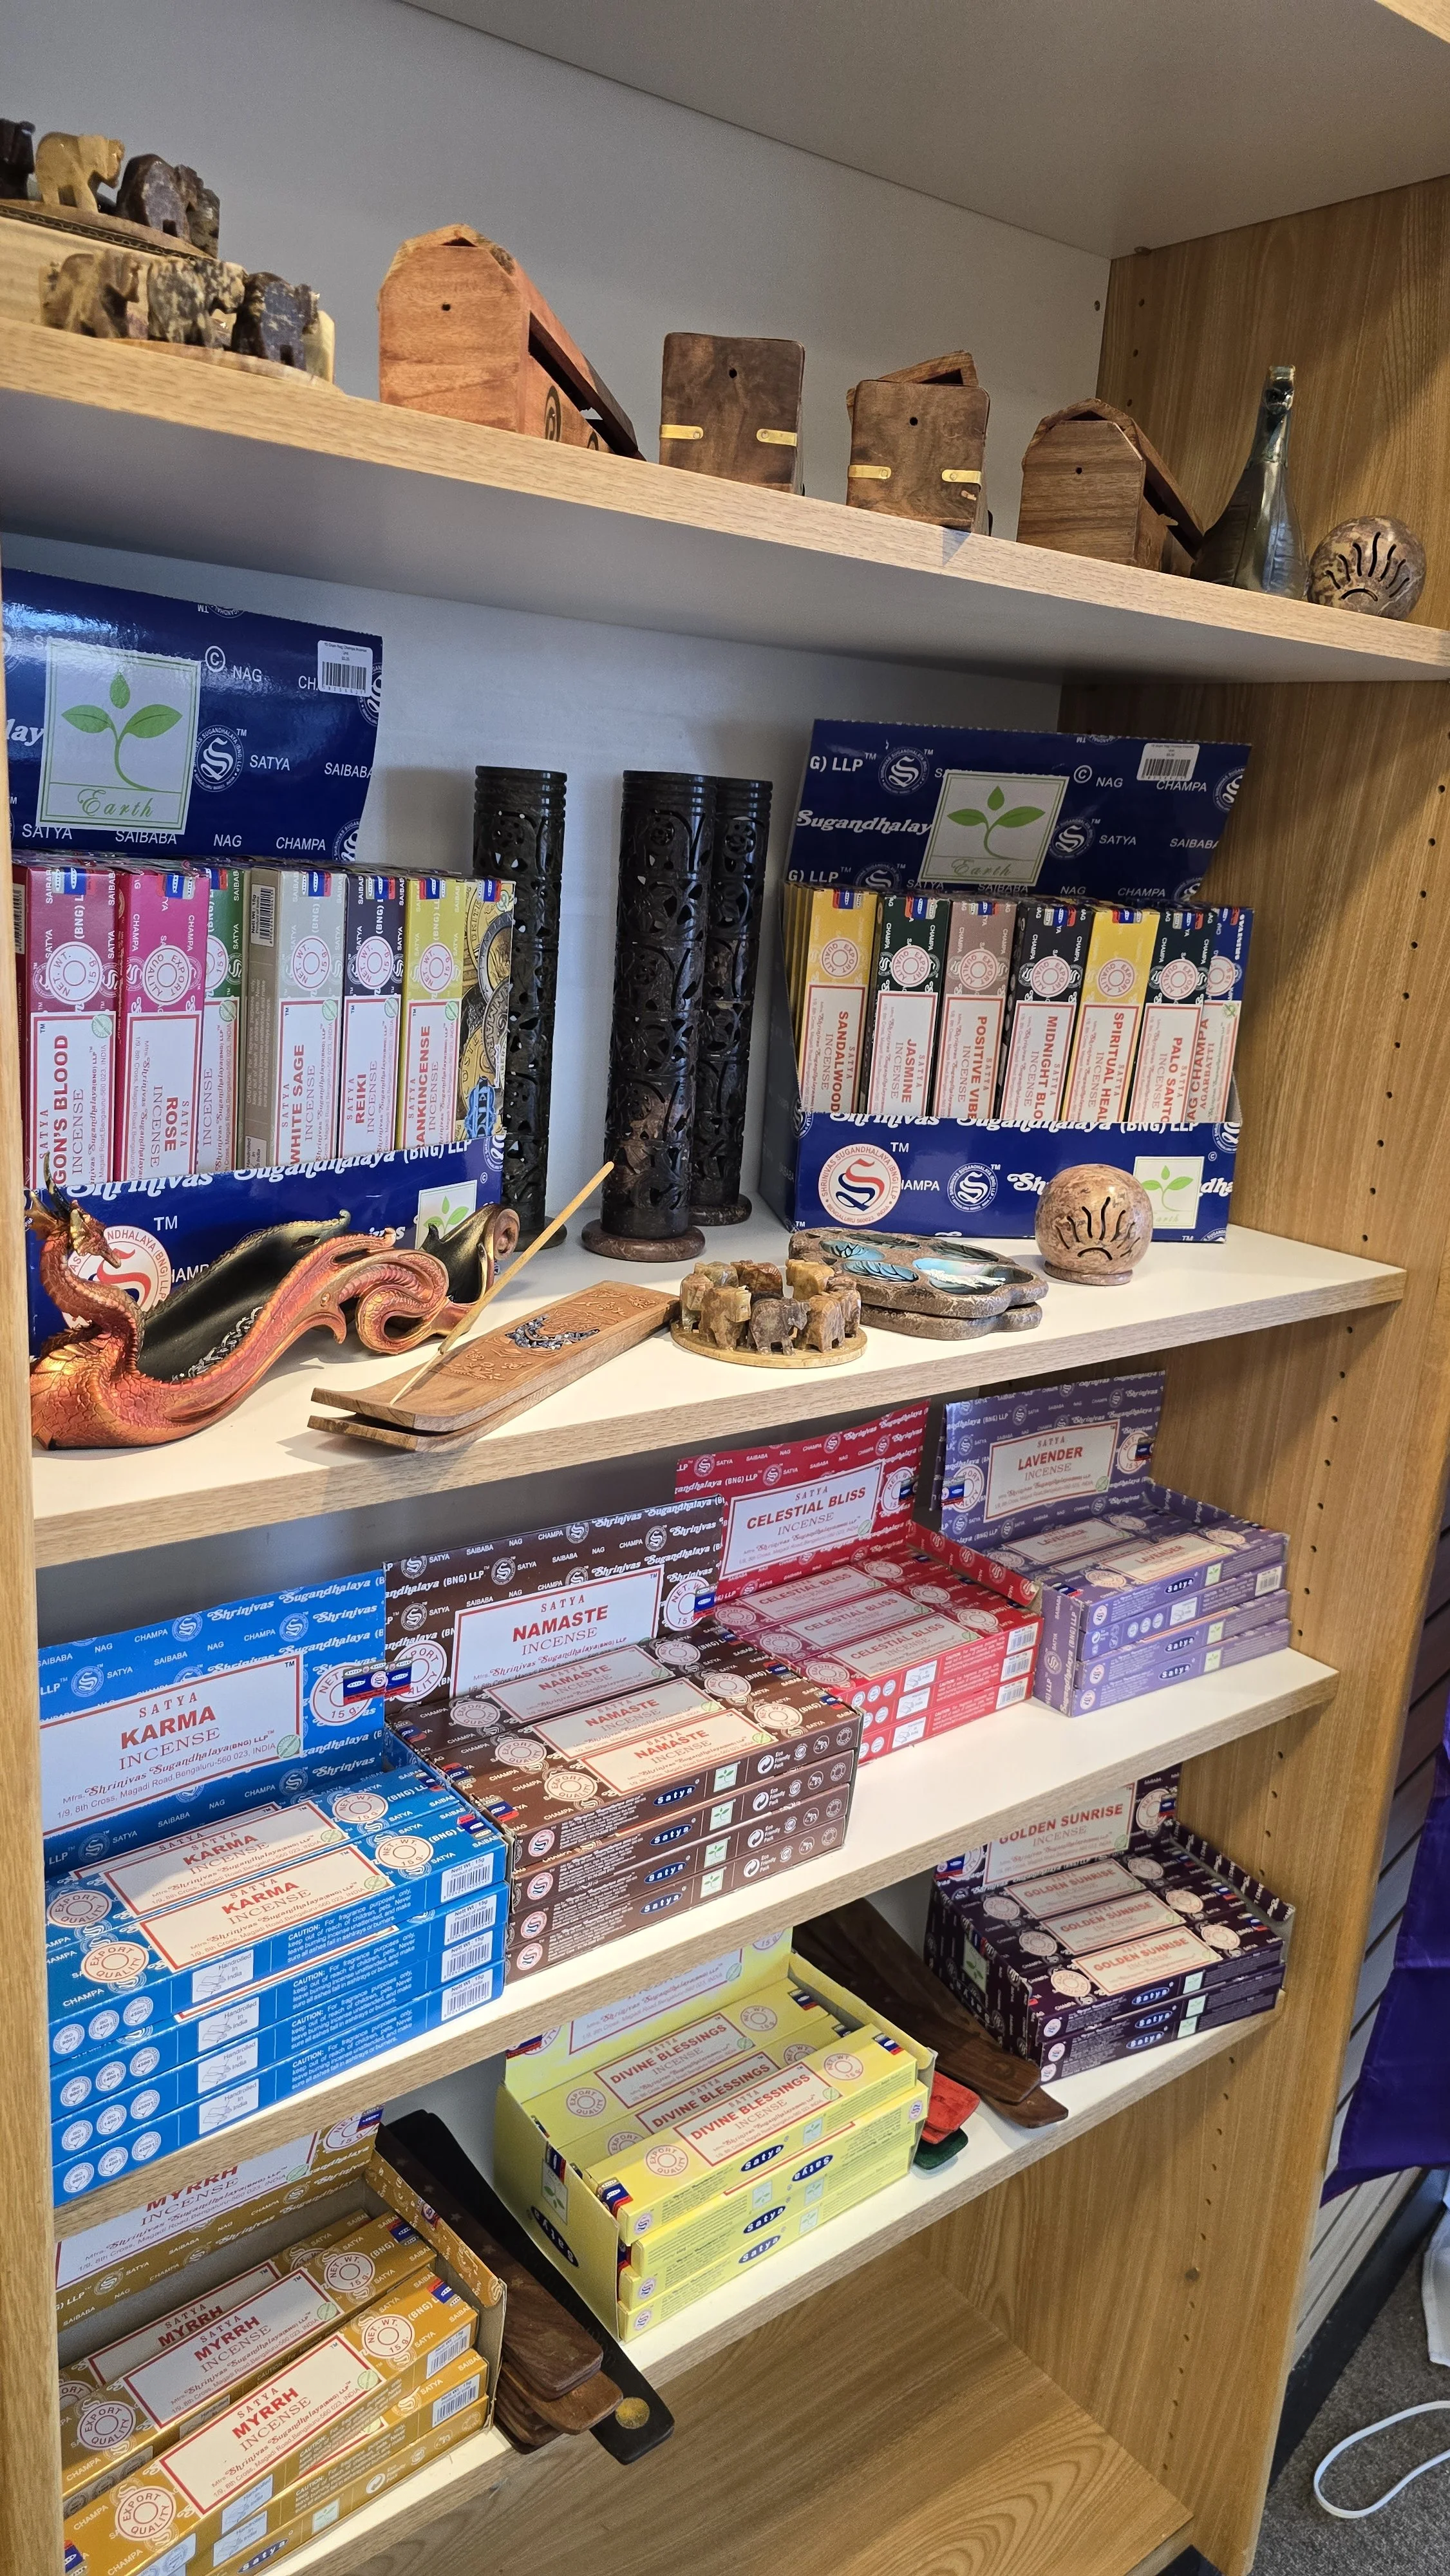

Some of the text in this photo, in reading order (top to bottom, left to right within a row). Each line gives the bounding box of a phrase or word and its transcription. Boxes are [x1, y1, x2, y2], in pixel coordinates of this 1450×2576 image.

[233, 666, 263, 683] NAG
[250, 755, 290, 771] SATYA
[832, 757, 863, 772] LLP
[1096, 777, 1124, 788] NAG
[77, 788, 153, 818] Earth
[22, 824, 326, 851] SATYA NAG CHAMPA
[1099, 835, 1136, 846] SATYA
[808, 870, 839, 884] LLP
[951, 858, 1012, 878] Earth
[1060, 885, 1166, 898] NAG CHAMPA
[311, 902, 319, 934] (BNG)
[821, 1033, 833, 1091] INCENSE
[830, 1010, 849, 1112] SANDALWOOD
[890, 1042, 904, 1099] INCENSE
[901, 1038, 917, 1104] JASMINE
[968, 1016, 987, 1119] POSITIVE VIBE
[1033, 1016, 1058, 1119] MIDNIGHT BLO
[1097, 1012, 1124, 1122] SPIRITUAL HEAL
[1191, 1019, 1209, 1092] CHAMPA
[53, 1035, 69, 1111] BLOOD
[957, 1046, 971, 1103] INCENSE
[1024, 1051, 1039, 1106] INCENSE
[1088, 1052, 1104, 1108] INCENSE
[1152, 1054, 1167, 1109] INCENSE
[1161, 1037, 1183, 1122] PALO SANTO
[1200, 1043, 1214, 1109] AGARBATTI
[203, 1068, 212, 1146] INCENSE
[290, 1044, 306, 1164] WHITE SAGE
[305, 1065, 315, 1141] INCENSE
[355, 1073, 367, 1124] REIKI
[366, 1060, 378, 1133] INCENSE
[429, 1061, 438, 1131] INCENSE
[71, 1088, 84, 1175] INCENSE
[151, 1085, 164, 1168] INCENSE
[164, 1097, 179, 1151] ROSE
[180, 1100, 190, 1148] SATYA
[835, 1146, 890, 1164] SUGANDHALAYA
[890, 1142, 909, 1152] TM
[153, 1215, 179, 1231] TM
[1037, 1436, 1066, 1448] SATYA
[1018, 1446, 1084, 1471] LAVENDER
[1024, 1463, 1072, 1481] INCENSE
[725, 1473, 758, 1488] (BNG) LLP
[795, 1486, 829, 1501] SATYA
[746, 1486, 866, 1530] CELESTIAL BLISS
[777, 1511, 834, 1536] INCENSE
[466, 1511, 642, 1556] SAIBABA Shrinivas
[1037, 1529, 1087, 1546] LAVENDER
[443, 1520, 717, 1588] (BNG) LLP Shrinivas
[591, 1544, 711, 1578] Shrinivas Sugandhalaya
[1135, 1545, 1183, 1564] LAVENDER
[207, 1580, 371, 1622] Shrinivas Sugandhalaya
[759, 1573, 852, 1605] CELESTIAL BLISS
[1167, 1578, 1194, 1592] Satya
[540, 1595, 586, 1613] SATYA
[804, 1597, 898, 1632] CELESTIAL BLISS
[134, 1628, 168, 1643] CHAMPA
[243, 1603, 377, 1642] CHAMPA Shrinivas
[512, 1605, 608, 1643] NAMASTE
[95, 1642, 188, 1666] NAG SAIBABA
[522, 1627, 598, 1656] INCENSE
[850, 1622, 946, 1660] CELESTIAL BLISS
[1166, 1637, 1194, 1651] Satya
[107, 1666, 133, 1680] SATYA
[538, 1664, 611, 1691] NAMASTE
[1162, 1663, 1191, 1679] Satya
[138, 1691, 198, 1719] SATYA
[584, 1699, 657, 1727] NAMASTE
[120, 1705, 216, 1750] KARMA
[118, 1727, 220, 1771] INCENSE
[634, 1730, 710, 1759] NAMASTE
[650, 1740, 712, 1765] INCENSE
[73, 1741, 276, 1815] 8th Cross, Magadi INDIA
[84, 1771, 147, 1799] Shrinivas
[244, 1783, 276, 1798] CHAMPA
[657, 1787, 693, 1804] Satya
[112, 1811, 191, 1844] SATYA SAIBABA
[1060, 1803, 1124, 1827] SUNRISE
[182, 1835, 258, 1866] KARMA
[654, 1826, 689, 1844] Satya
[1033, 1825, 1087, 1846] INCENSE
[189, 1842, 270, 1875] INCENSE
[221, 1882, 299, 1915] KARMA
[1023, 1879, 1064, 1899] GOLDEN
[1066, 1868, 1115, 1888] SUNRISE
[1060, 1901, 1153, 1933] GOLDEN SUNRISE
[1093, 1937, 1189, 1973] GOLDEN SUNRISE
[227, 1971, 243, 1981] India
[62, 1987, 105, 2008] CHAMPA
[609, 2023, 728, 2085] DIVINE BLESSINGS
[652, 2047, 704, 2075] INCENSE
[650, 2063, 771, 2128] DIVINE BLESSINGS
[690, 2074, 811, 2141] DIVINE BLESSINGS
[733, 2099, 789, 2130] INCENSE
[744, 2146, 782, 2171] Satya
[140, 2177, 240, 2226] INCENSE
[146, 2165, 238, 2212] MYRRH
[746, 2207, 784, 2232] Satya
[742, 2236, 780, 2262] Satya
[157, 2305, 223, 2349] MYRRH
[165, 2303, 206, 2329] SATYA
[200, 2316, 241, 2343] SATYA
[193, 2316, 260, 2362] MYRRH
[201, 2325, 272, 2373] INCENSE
[231, 2387, 299, 2439] MYRRH
[237, 2387, 279, 2419] SATYA
[238, 2396, 312, 2452] INCENSE
